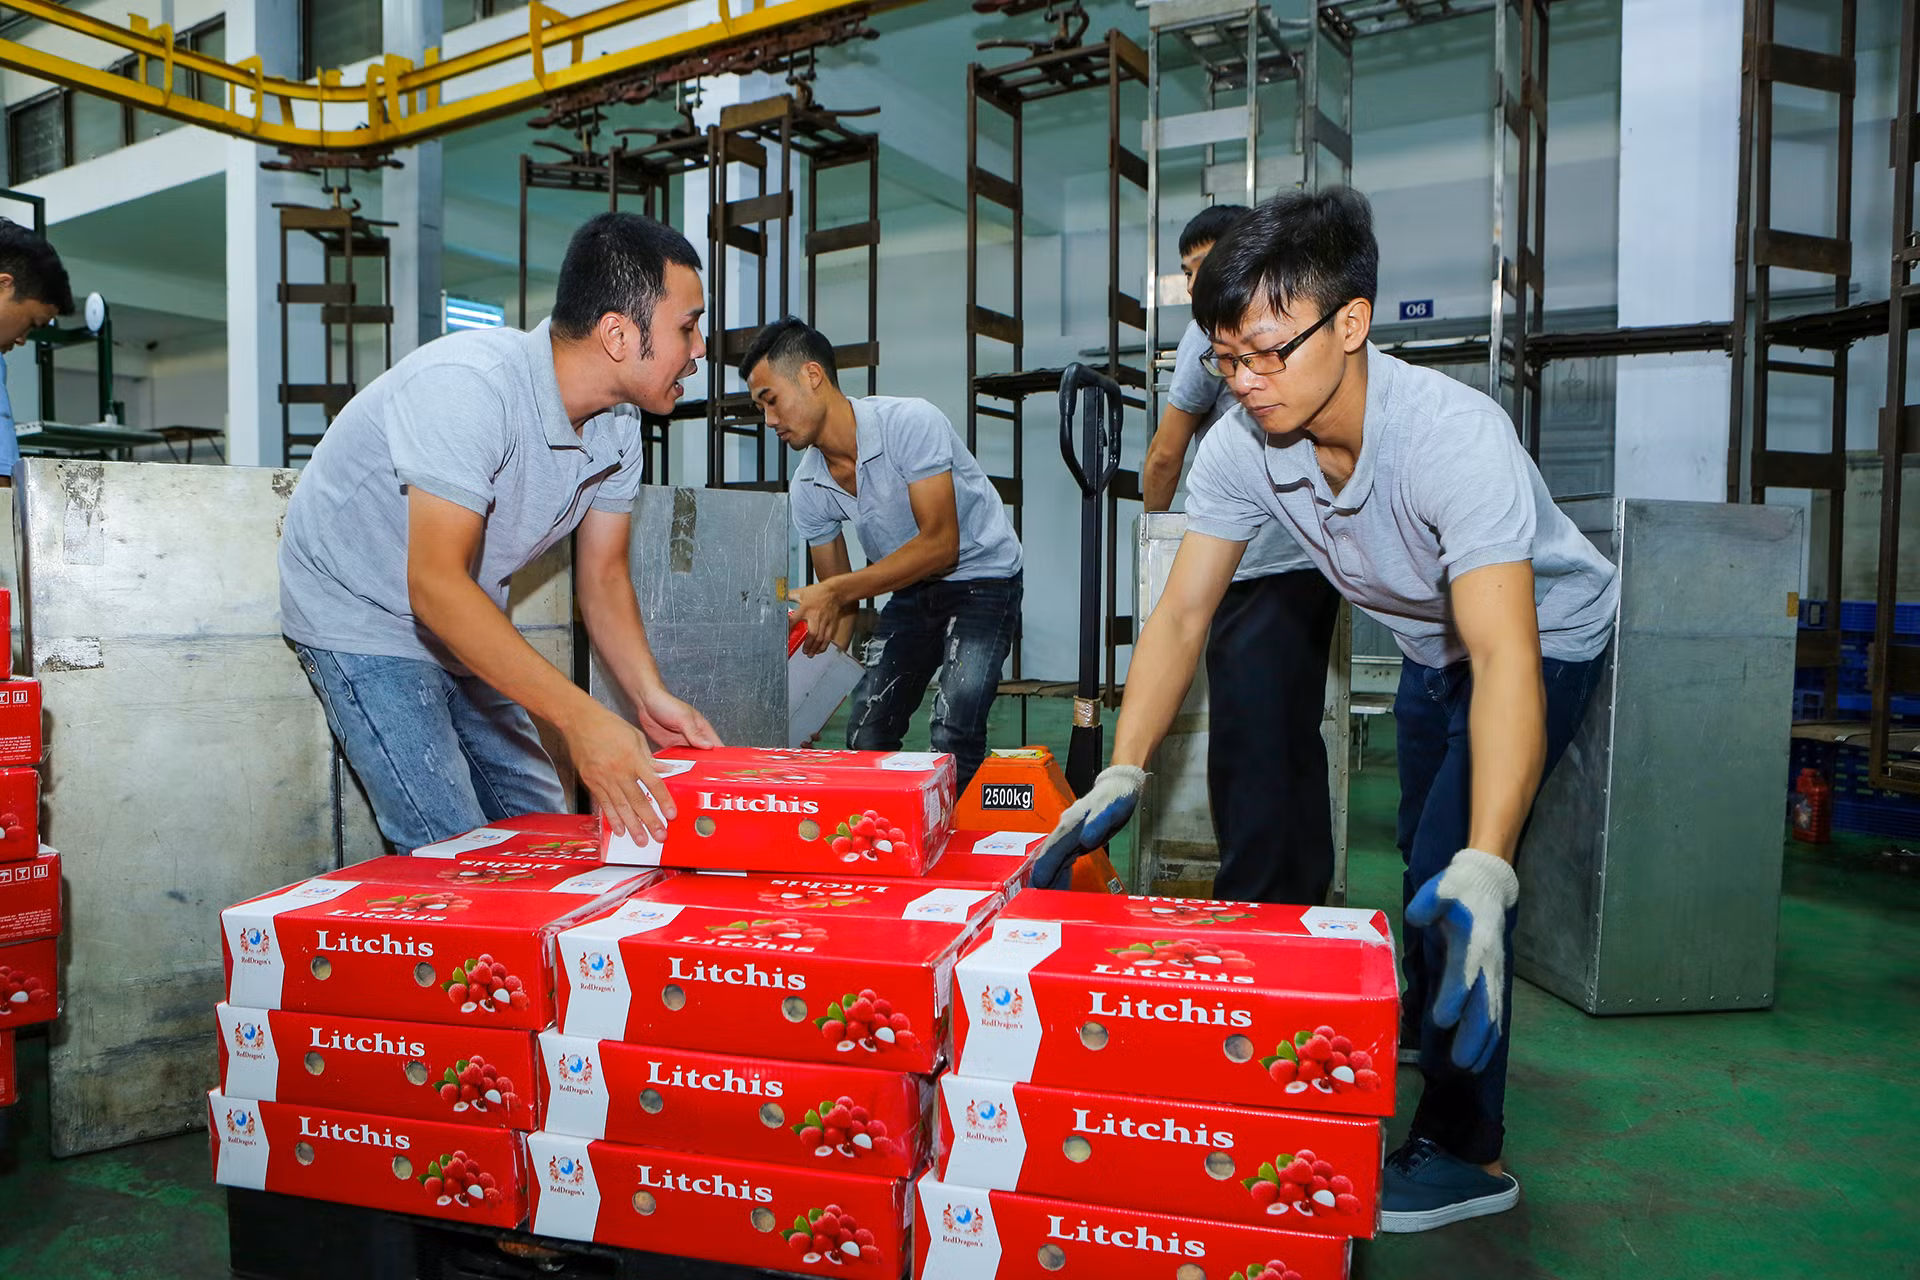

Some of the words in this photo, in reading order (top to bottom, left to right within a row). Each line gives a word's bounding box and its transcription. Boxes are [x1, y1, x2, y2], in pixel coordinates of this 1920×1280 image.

[1406, 303, 1427, 316] 06
[699, 791, 819, 814] Litchis
[984, 787, 1033, 809] 2500kg
[459, 860, 566, 871] Litchis
[771, 879, 890, 893] Litchis
[325, 909, 447, 921] Litchis
[316, 929, 434, 957] Litchis
[676, 935, 815, 953] Litchis
[668, 957, 807, 991] Litchis
[1091, 963, 1255, 984] Litchis
[580, 983, 616, 993] RedDragon's
[1088, 991, 1253, 1028] Litchis
[981, 1018, 1024, 1030] RedDragon's
[309, 1026, 425, 1058] Litchis
[559, 1084, 594, 1095] RedDragon's
[646, 1060, 784, 1098] Litchis
[298, 1115, 411, 1150] Litchis
[966, 1131, 1008, 1144] RedDragon's
[1072, 1108, 1235, 1148] Litchis
[549, 1185, 585, 1197] RedDragon's
[637, 1164, 773, 1203] Litchis
[942, 1234, 984, 1248] RedDragon's
[1047, 1214, 1206, 1257] Litchis
